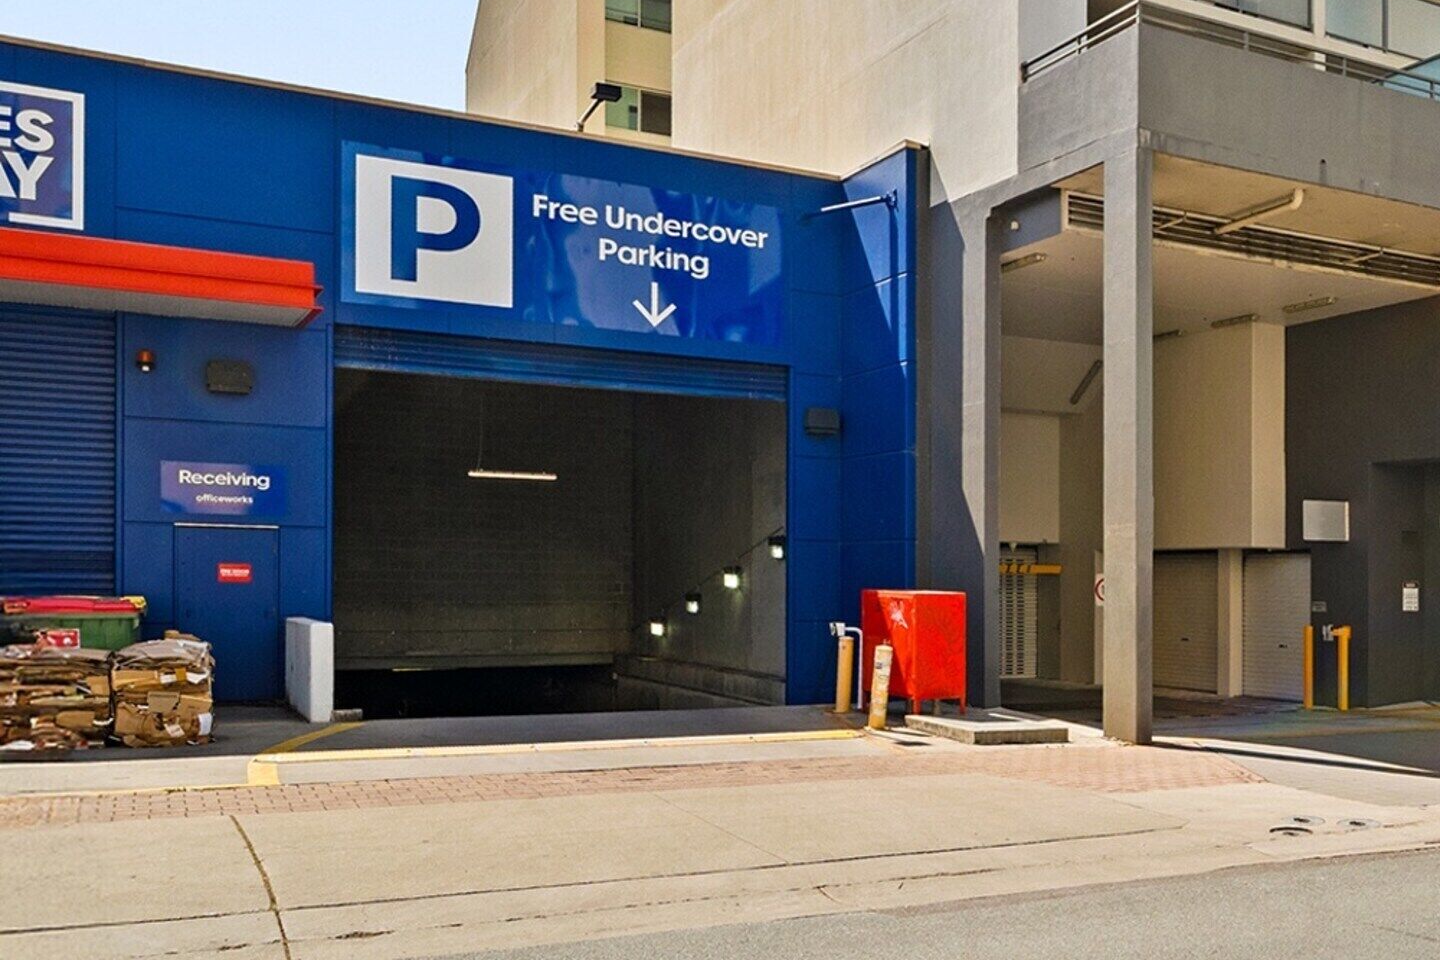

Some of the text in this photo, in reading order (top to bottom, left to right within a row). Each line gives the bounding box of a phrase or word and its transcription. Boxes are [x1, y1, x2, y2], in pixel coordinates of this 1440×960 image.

[390, 174, 481, 283] P
[532, 193, 769, 249] Free Undercover
[598, 238, 711, 280] Parking
[178, 468, 271, 491] Receiving
[195, 493, 254, 505] officeworks
